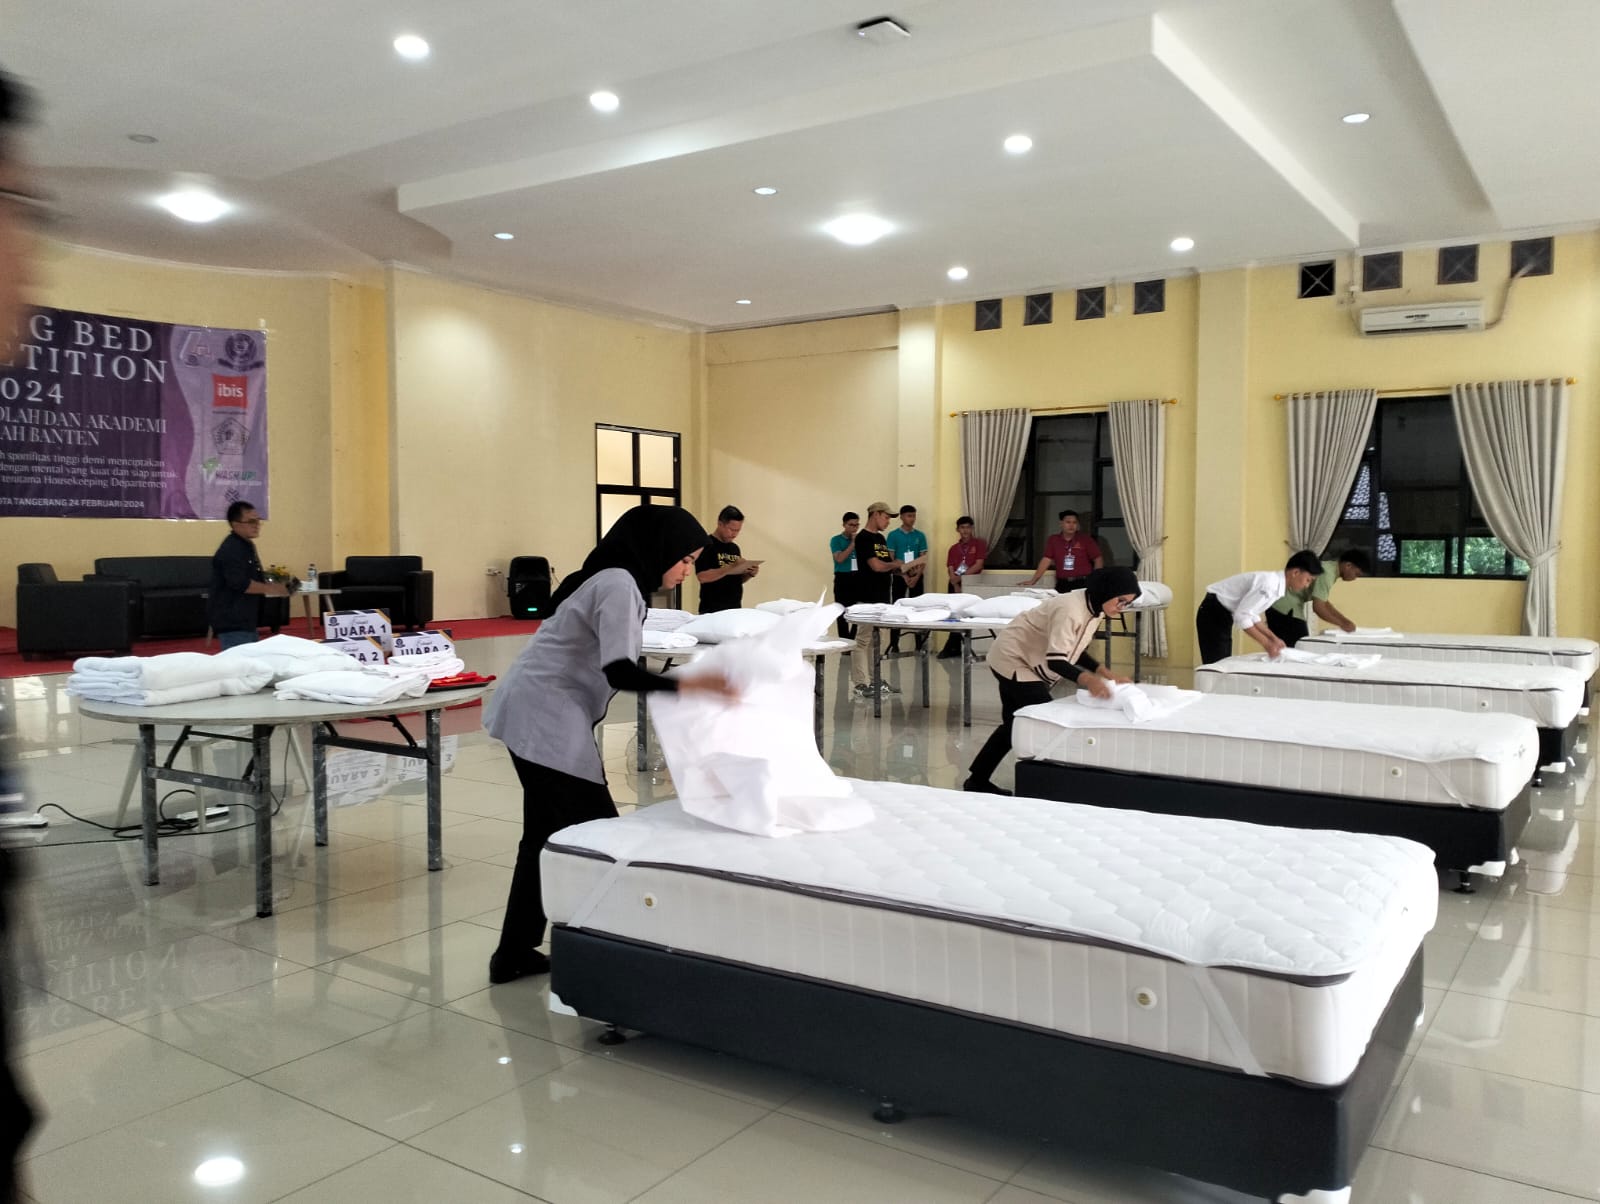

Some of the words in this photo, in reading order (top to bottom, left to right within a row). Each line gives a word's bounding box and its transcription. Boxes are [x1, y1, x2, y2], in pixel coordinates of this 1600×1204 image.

[73, 320, 153, 352] BED
[0, 377, 64, 404] 024
[217, 383, 244, 398] ibis
[43, 410, 81, 428] DAN
[86, 414, 167, 434] AKADEMI
[30, 427, 99, 446] BANTEN
[53, 454, 80, 466] tinggi
[82, 455, 106, 465] demi
[107, 457, 165, 468] menciptakan
[31, 464, 64, 474] mental
[64, 466, 88, 478] yang
[112, 467, 129, 477] dan
[151, 469, 177, 479] untuk
[43, 475, 109, 489] Housekeeping
[13, 497, 68, 507] TANGERANG
[68, 499, 80, 507] 24
[81, 499, 121, 508] FEBRUARI
[123, 500, 145, 508] 2024
[334, 624, 376, 639] JUARA
[380, 624, 387, 633] 1
[371, 651, 380, 662] 2
